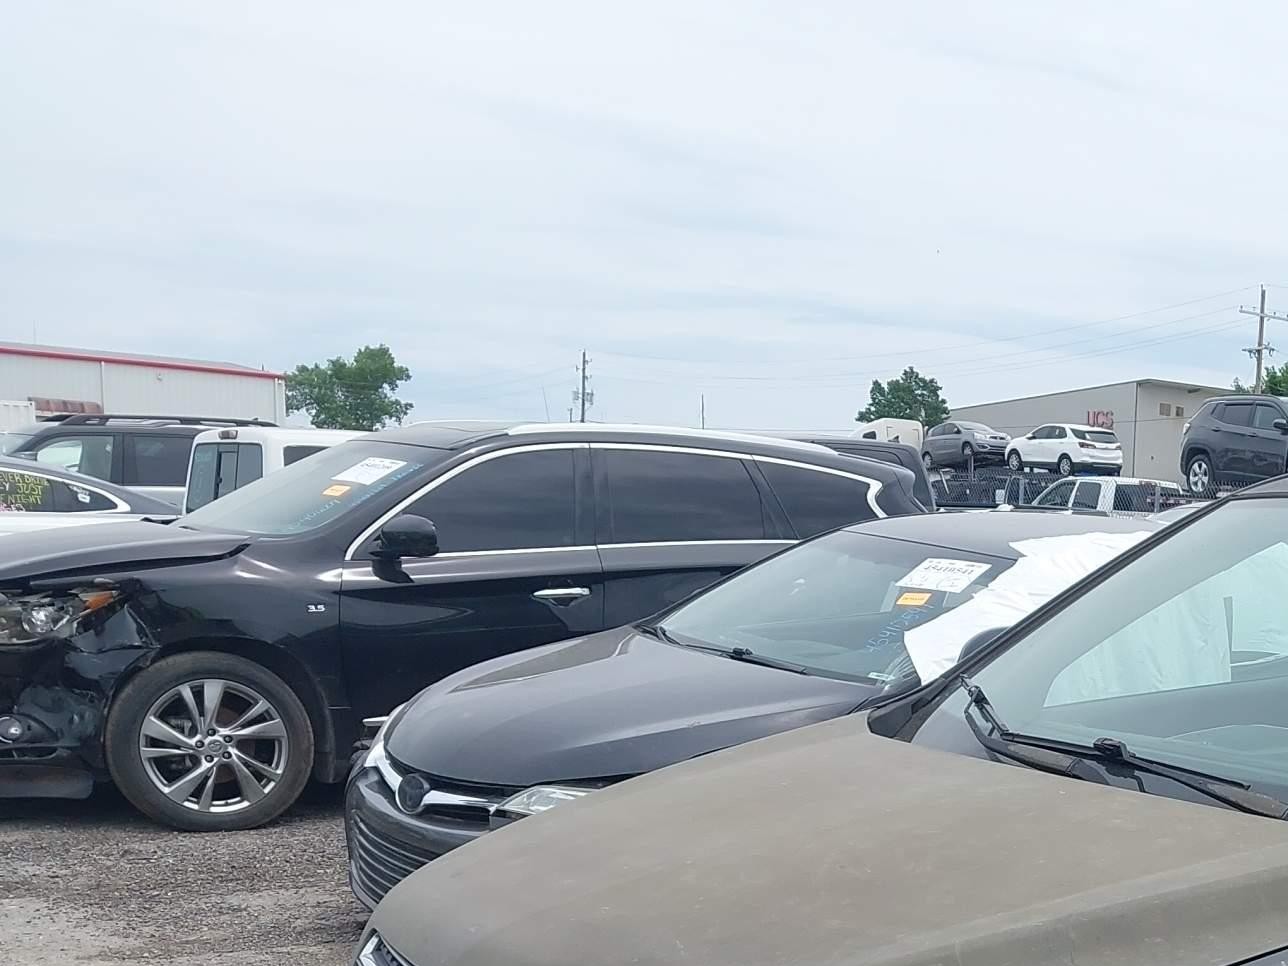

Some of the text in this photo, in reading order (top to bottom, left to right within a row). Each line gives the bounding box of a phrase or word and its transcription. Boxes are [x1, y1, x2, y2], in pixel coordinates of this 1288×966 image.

[1087, 410, 1115, 430] UCS
[16, 483, 43, 496] JUST
[8, 494, 43, 505] NIGHT
